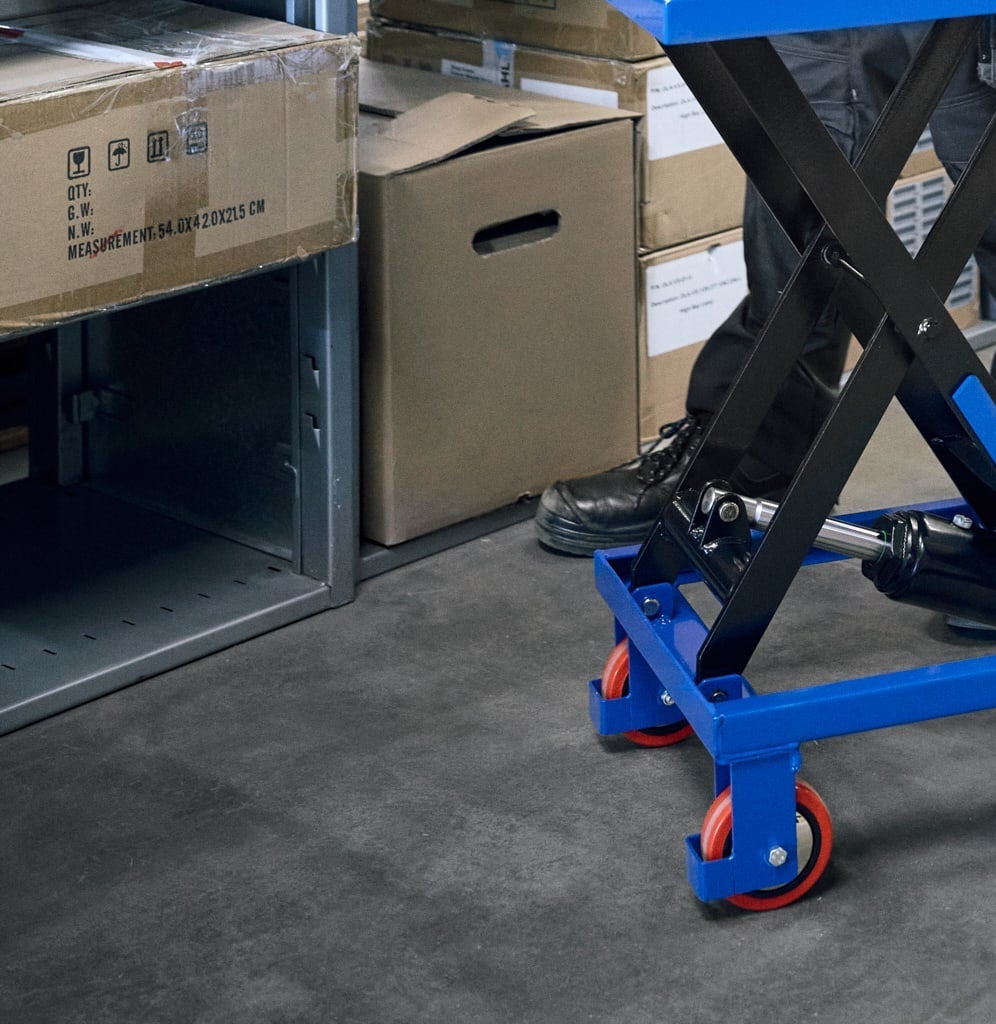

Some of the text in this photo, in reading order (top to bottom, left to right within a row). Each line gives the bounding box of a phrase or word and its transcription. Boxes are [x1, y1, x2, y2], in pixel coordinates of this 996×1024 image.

[68, 182, 92, 201] QTY:
[68, 202, 94, 221] G.W:
[68, 221, 94, 241] N.W:
